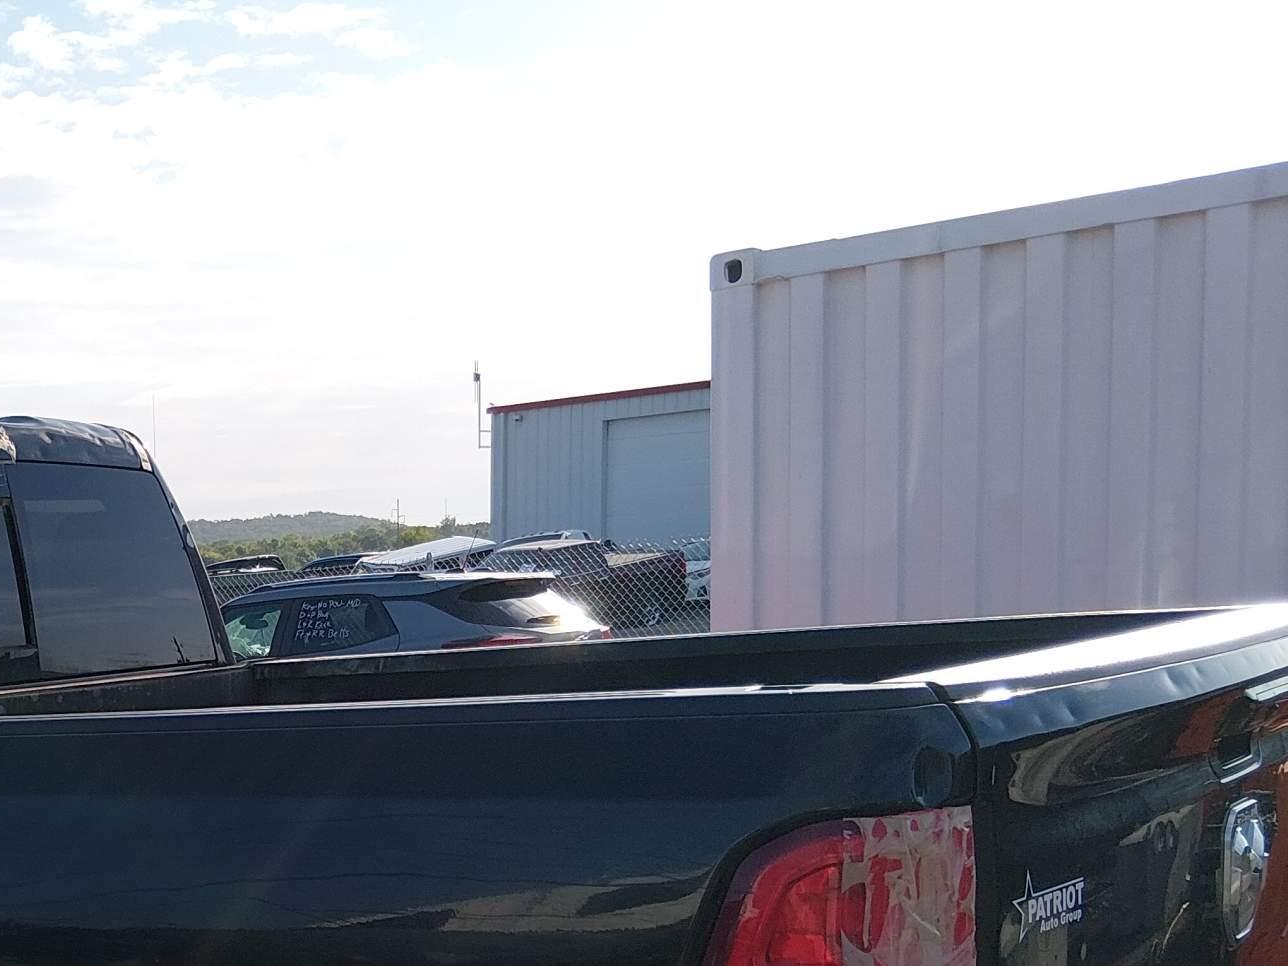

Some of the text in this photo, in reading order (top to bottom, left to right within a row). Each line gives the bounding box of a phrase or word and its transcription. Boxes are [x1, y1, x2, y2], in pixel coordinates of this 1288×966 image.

[1028, 881, 1085, 923] PATRIOT
[1040, 908, 1082, 933] Auto Group
